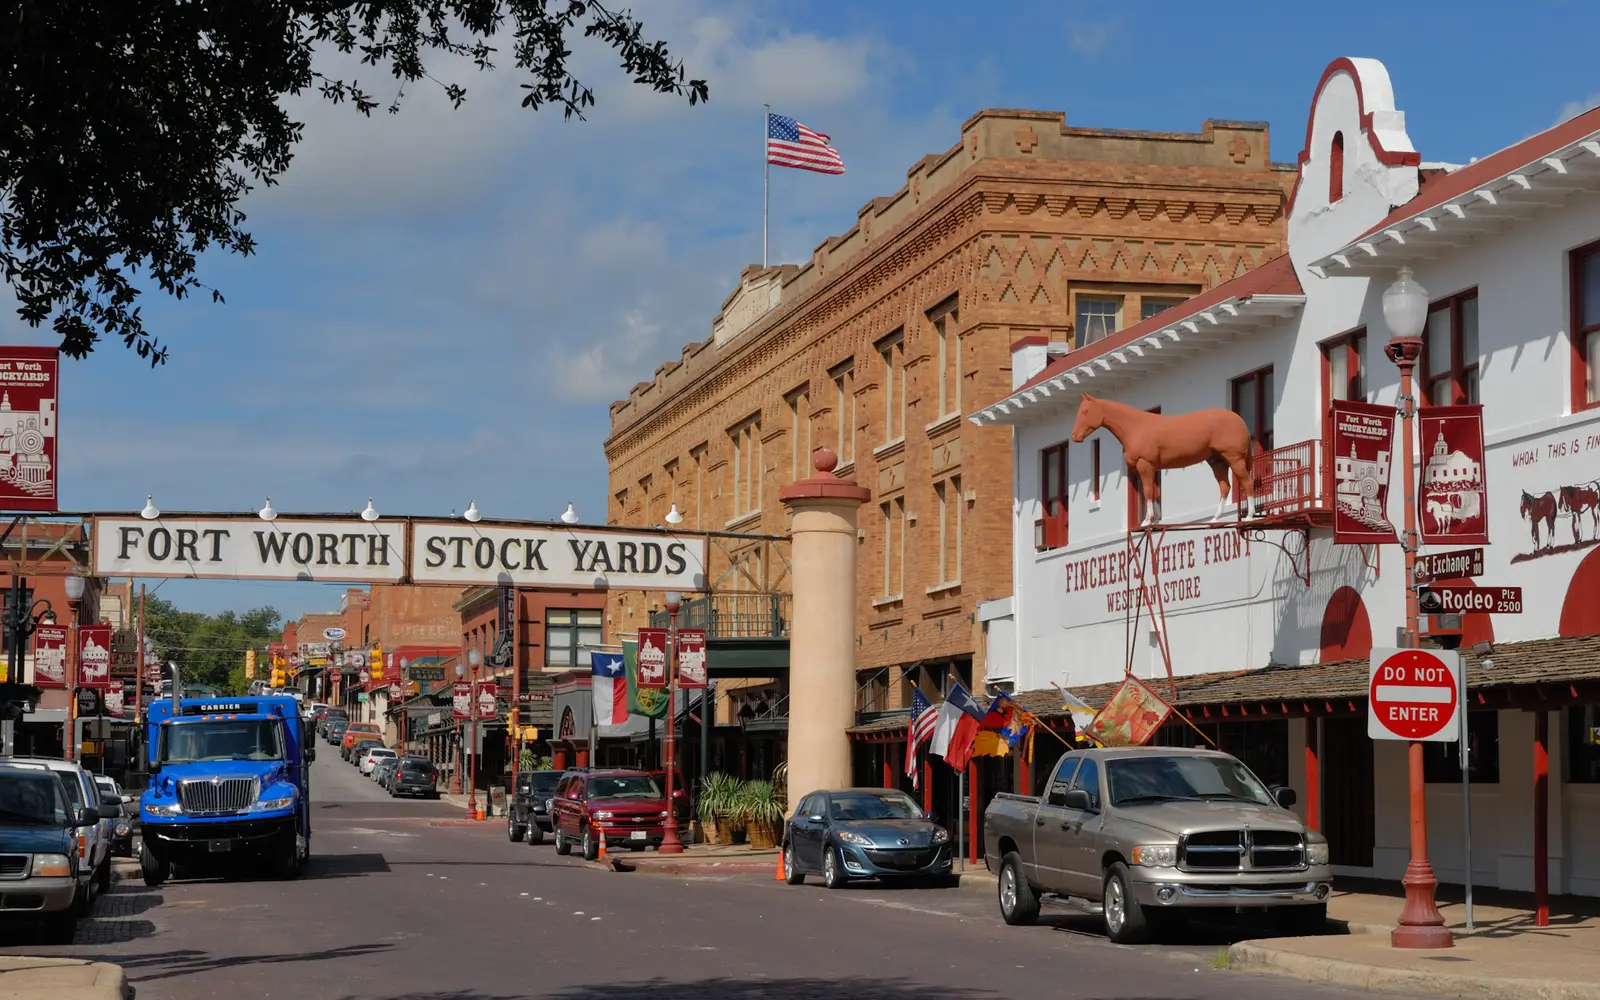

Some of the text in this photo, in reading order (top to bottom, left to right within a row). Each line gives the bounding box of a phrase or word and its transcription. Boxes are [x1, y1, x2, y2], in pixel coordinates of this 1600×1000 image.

[16, 362, 42, 371] Worth
[1345, 415, 1382, 427] Fort Worth
[1339, 423, 1388, 437] STOCKYARDS
[1512, 447, 1539, 467] WHOA!
[1547, 442, 1567, 459] THIS
[1570, 438, 1580, 455] IS
[118, 526, 391, 566] FORT WORTH
[1204, 528, 1253, 566] FRONT
[426, 536, 687, 575] STOCK YARDS
[1424, 556, 1430, 576] E
[1432, 551, 1471, 578] Exchange
[1473, 562, 1482, 575] 100
[1163, 576, 1201, 604] STORE
[1442, 588, 1516, 609] Rodeo Plz
[1497, 601, 1521, 612] 2500
[1384, 667, 1445, 683] DO NOT
[201, 703, 241, 711] CARRIER
[1389, 706, 1439, 722] ENTER
